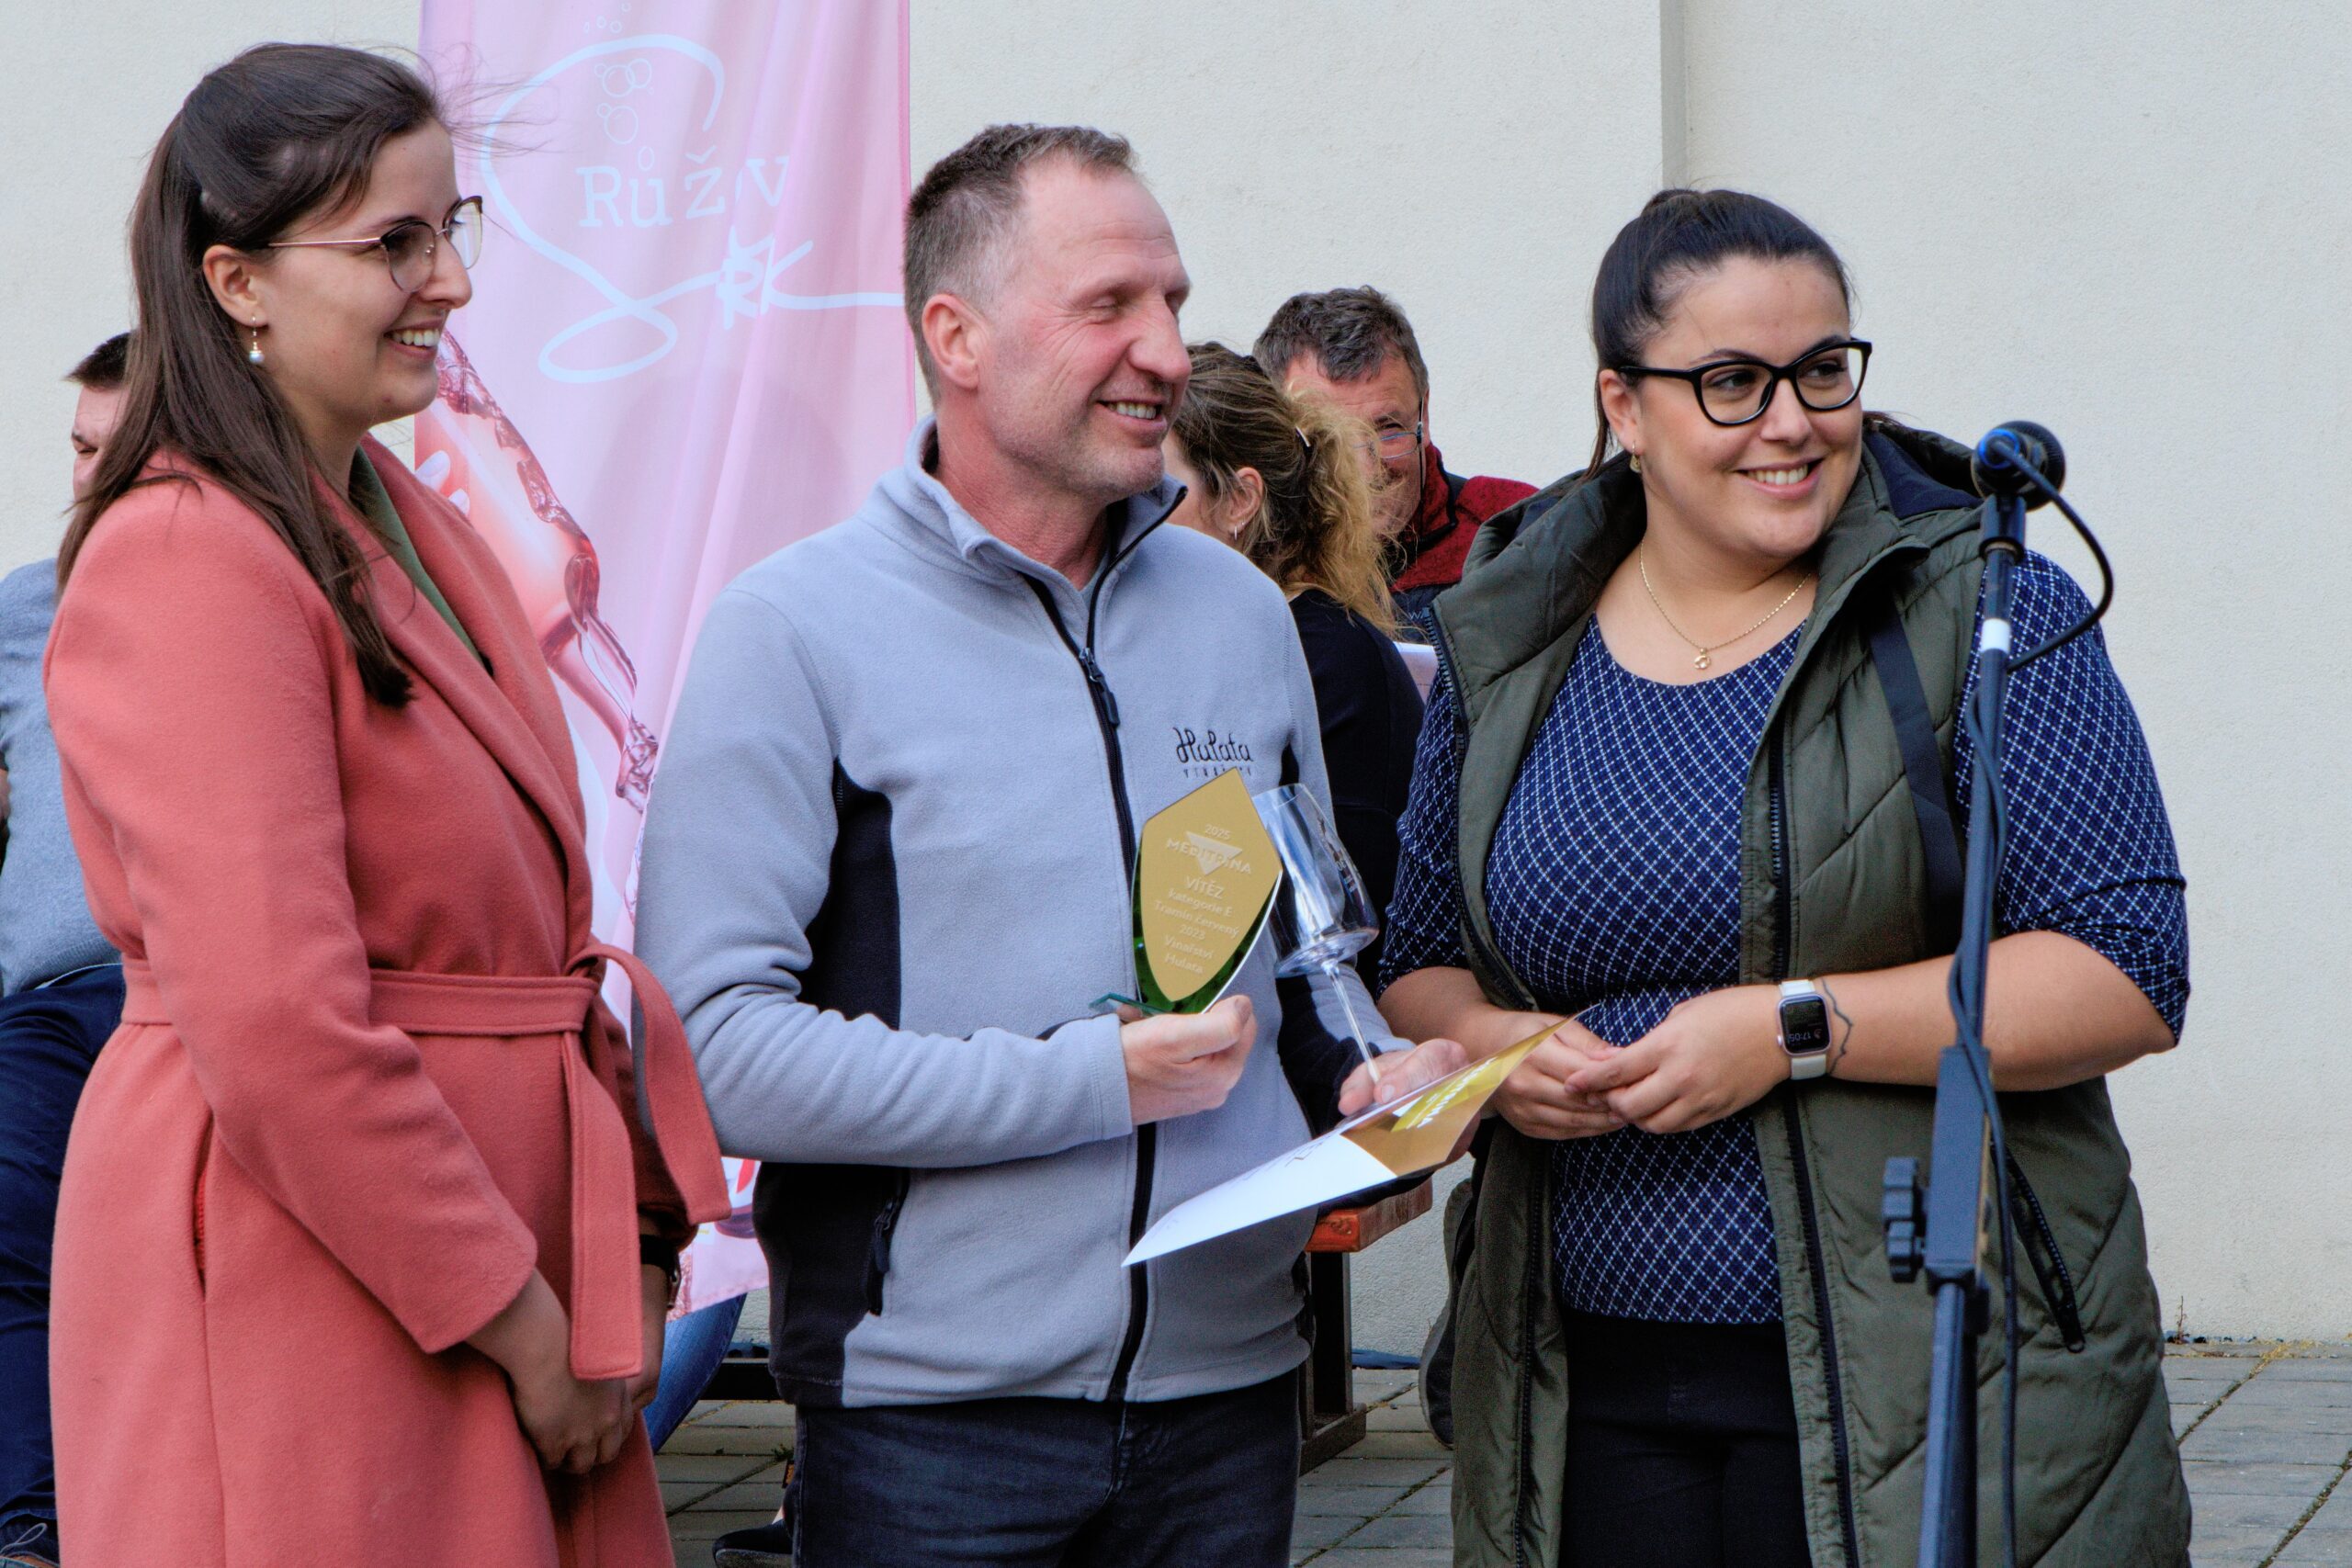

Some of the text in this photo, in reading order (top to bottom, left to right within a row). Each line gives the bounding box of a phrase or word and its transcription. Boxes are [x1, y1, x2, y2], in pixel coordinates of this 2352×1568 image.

[1204, 823, 1231, 840] 2025
[1166, 837, 1252, 875] MEDITRINA
[1185, 874, 1225, 899] VÍTĚZ
[1168, 887, 1234, 918] kategorie E
[1180, 924, 1206, 942] 2023
